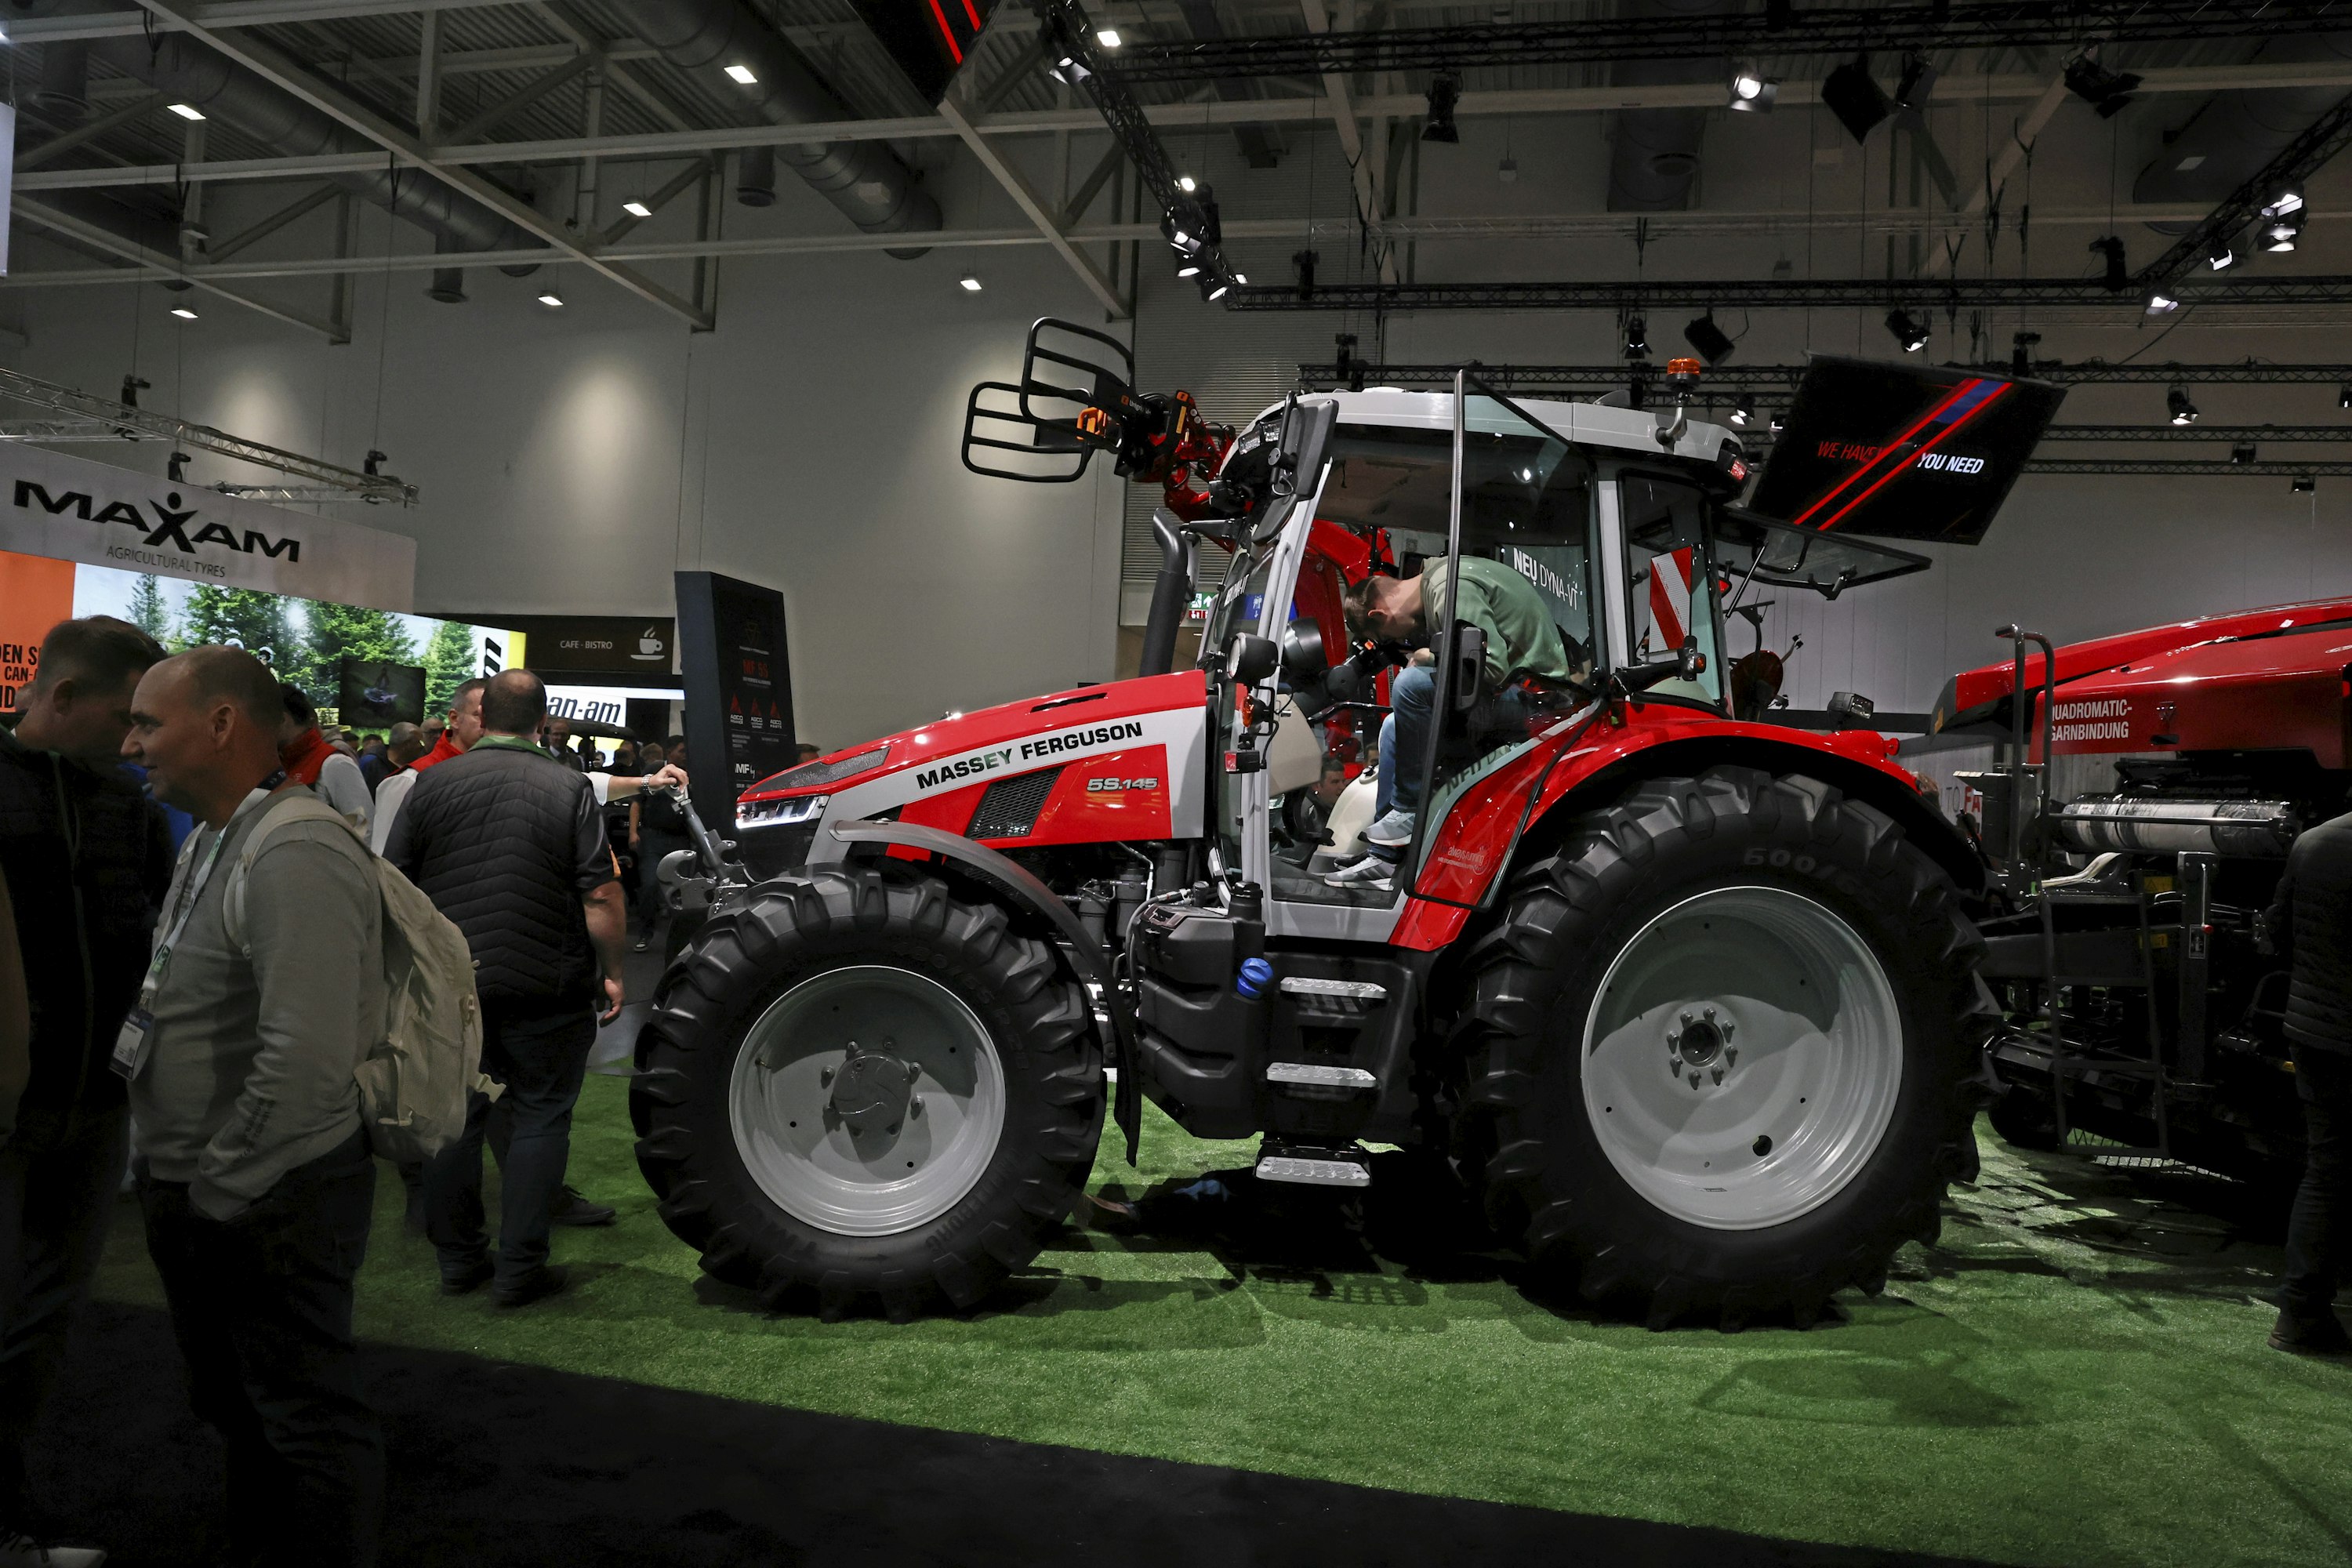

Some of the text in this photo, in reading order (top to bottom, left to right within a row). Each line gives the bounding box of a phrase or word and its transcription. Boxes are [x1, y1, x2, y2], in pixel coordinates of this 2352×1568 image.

[1817, 441, 1841, 459] WE
[1917, 452, 1985, 474] YOU NEED
[14, 480, 299, 561] MAXAM
[106, 545, 225, 578] AGRICULTURAL TYRES
[1540, 564, 1578, 611] DYNA-VT
[0, 644, 23, 664] EN
[560, 640, 579, 649] CAFE
[585, 641, 613, 650] BISTRO
[547, 696, 621, 724] an-am
[2052, 699, 2133, 721] UADROMATIC-
[916, 721, 1142, 789] MASSEY FERGUSON
[1087, 777, 1158, 792] 5S.145
